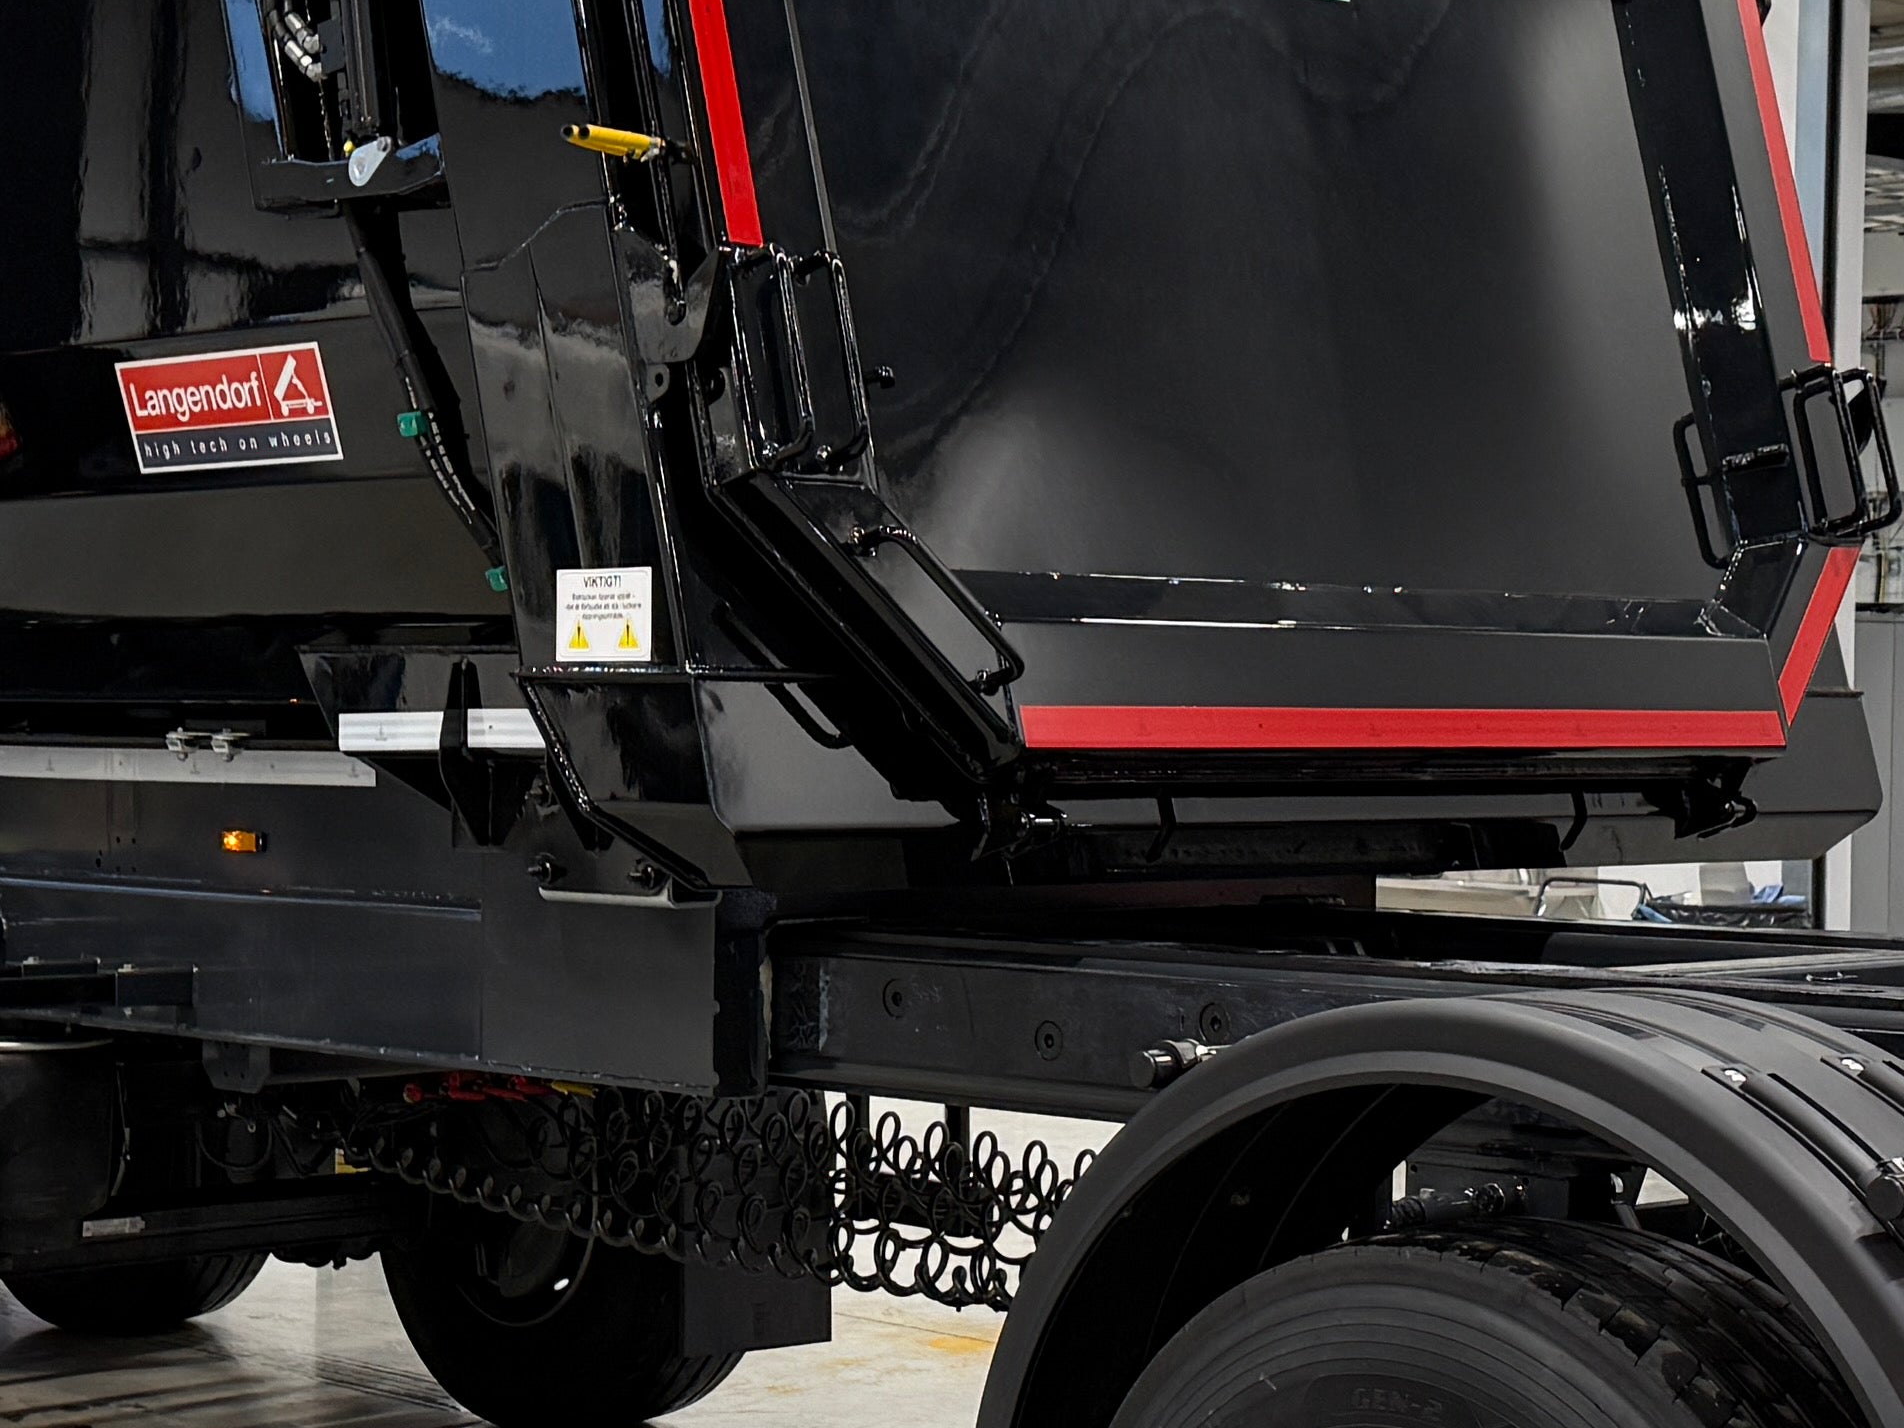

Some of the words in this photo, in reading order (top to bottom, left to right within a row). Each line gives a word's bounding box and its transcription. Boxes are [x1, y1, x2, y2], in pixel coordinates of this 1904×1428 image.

[129, 371, 262, 422] Langendorf
[144, 440, 180, 460] high
[191, 436, 228, 454] tech
[239, 437, 258, 451] on
[268, 429, 332, 448] wheels
